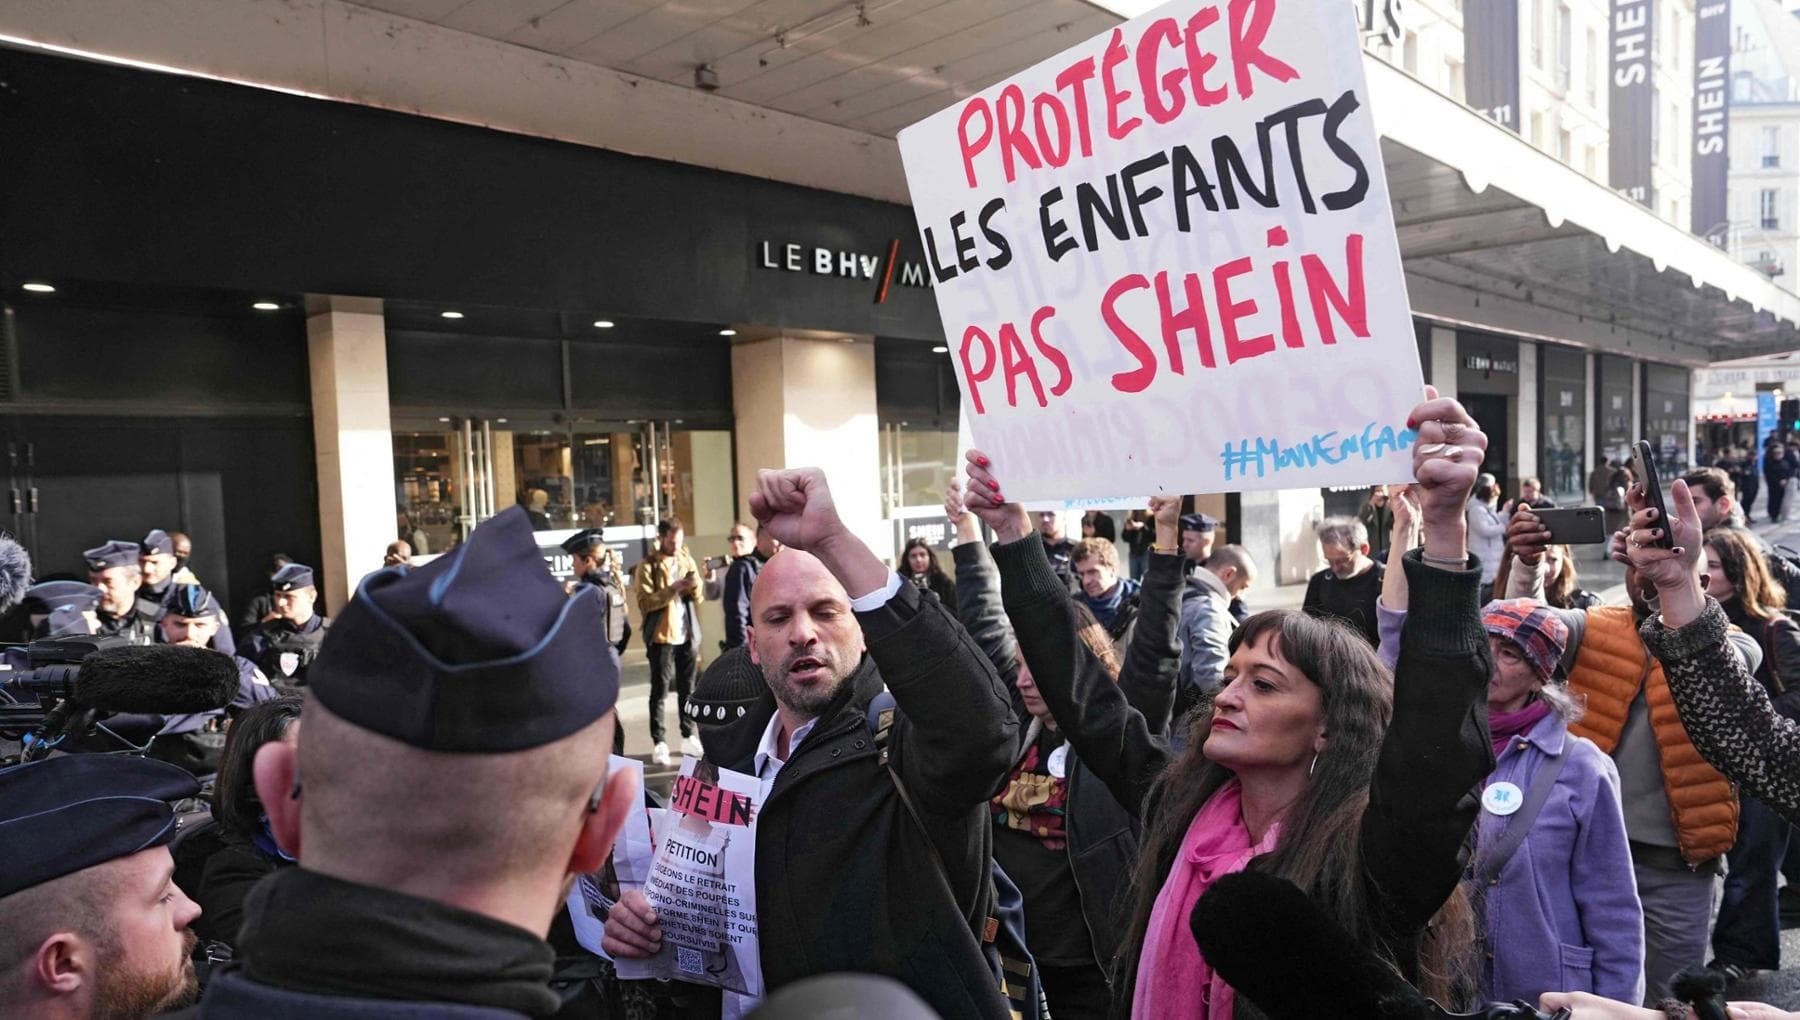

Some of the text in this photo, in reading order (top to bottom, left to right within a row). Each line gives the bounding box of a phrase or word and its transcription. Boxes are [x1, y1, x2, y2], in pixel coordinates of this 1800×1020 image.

[1697, 56, 1724, 155] SHEIN
[924, 90, 1370, 284] LES ENFANTS
[764, 241, 801, 271] LE
[815, 247, 878, 280] BHV
[959, 306, 1072, 414] PAS
[672, 775, 751, 828] SHEIN
[665, 838, 718, 868] PETITION
[676, 885, 694, 898] DES
[684, 874, 695, 885] LE
[697, 877, 737, 893] RETRAIT
[658, 918, 743, 944] CHETEURS SOIENT
[692, 914, 719, 928] SHEIN
[724, 921, 735, 930] ET
